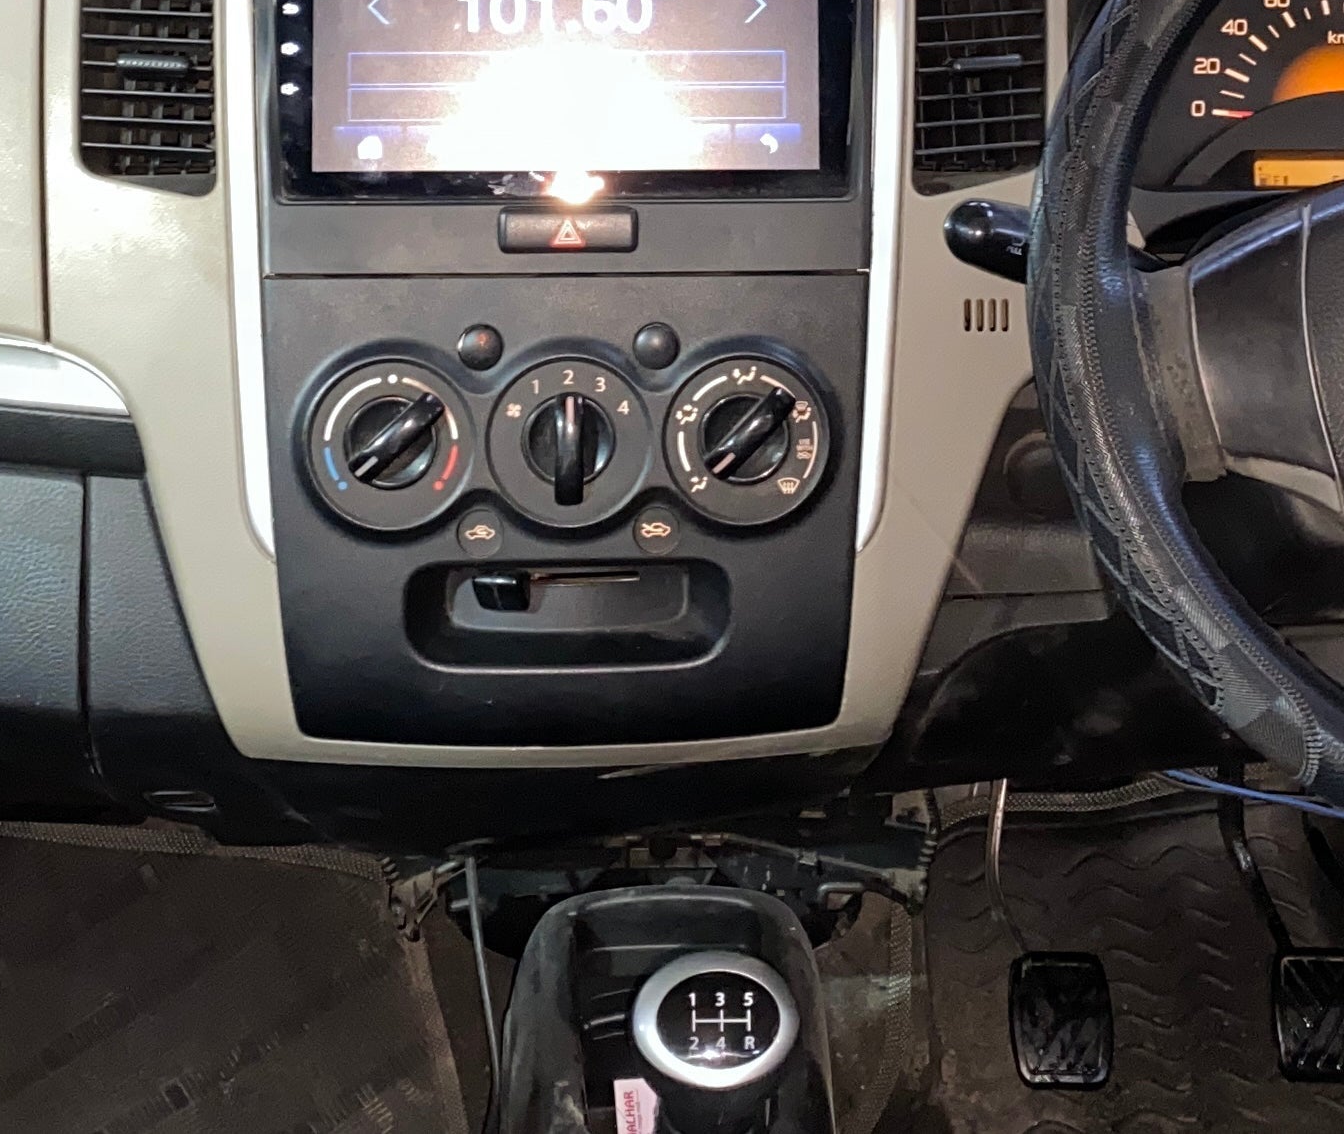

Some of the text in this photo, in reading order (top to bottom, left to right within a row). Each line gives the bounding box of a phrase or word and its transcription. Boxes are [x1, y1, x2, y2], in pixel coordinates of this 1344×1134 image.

[1220, 19, 1248, 35] 40
[1193, 58, 1220, 74] 20
[1191, 100, 1205, 117] 0
[532, 369, 630, 415] 1 2 3 4
[688, 992, 754, 1007] 1 3 5
[688, 1035, 755, 1050] 2 4 R
